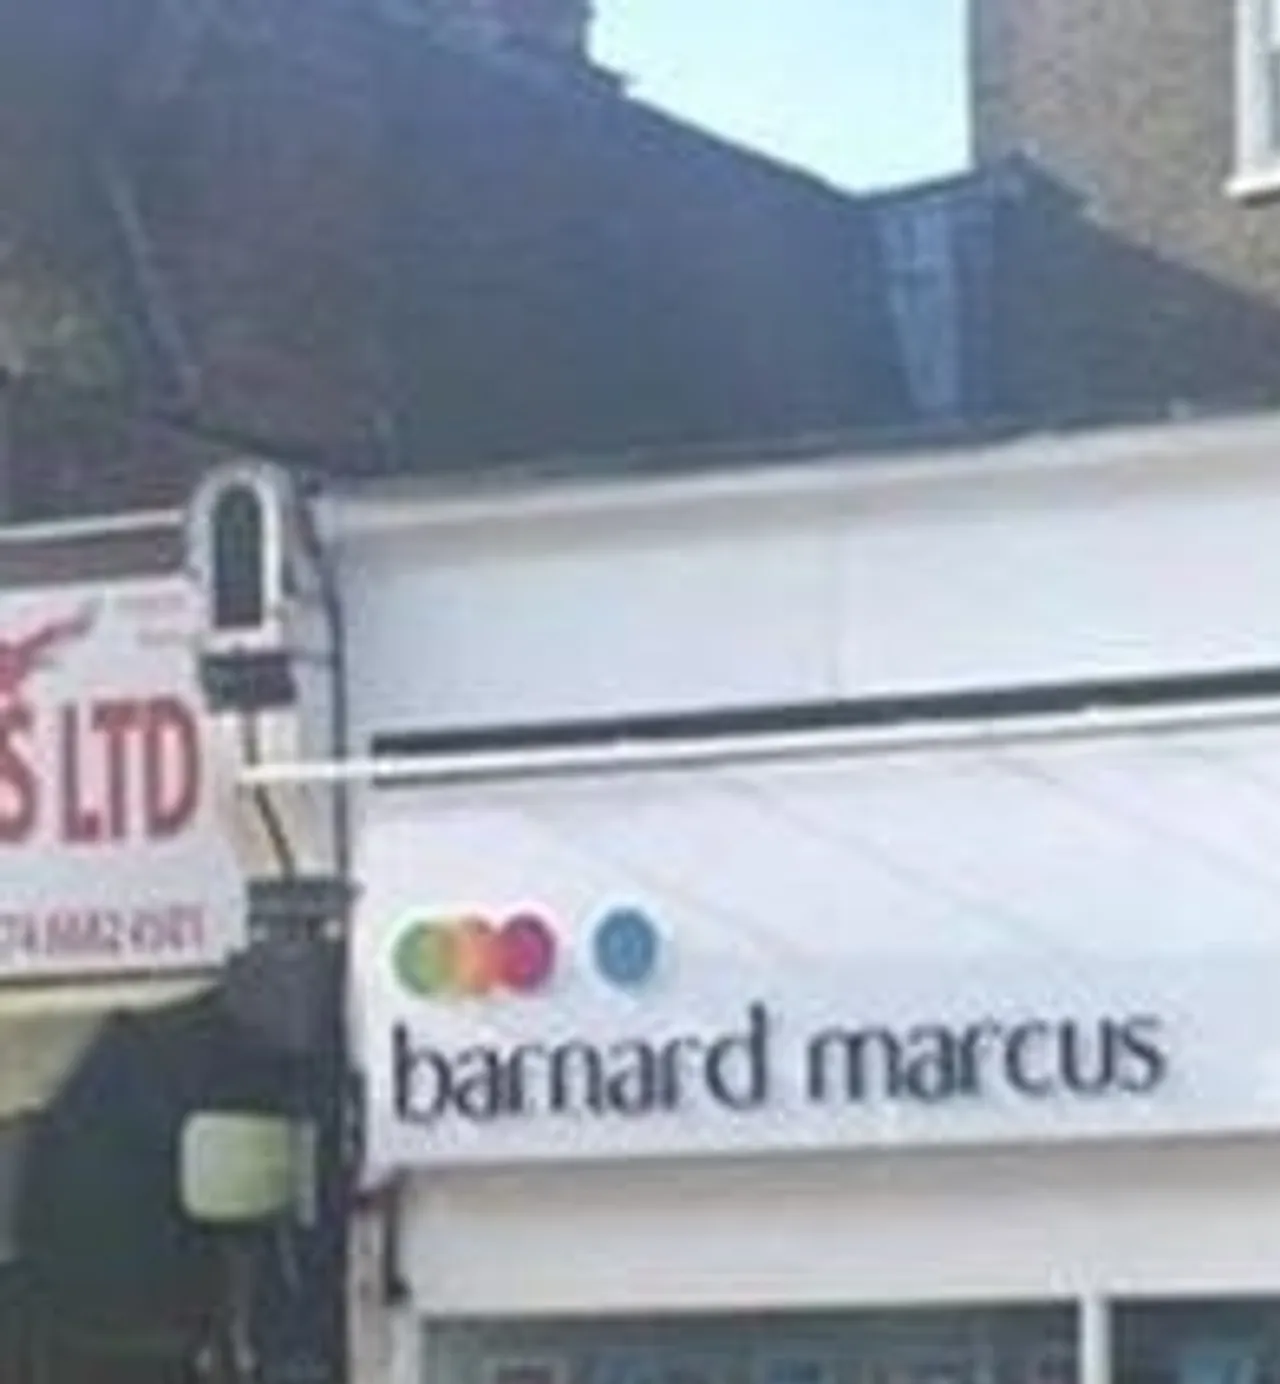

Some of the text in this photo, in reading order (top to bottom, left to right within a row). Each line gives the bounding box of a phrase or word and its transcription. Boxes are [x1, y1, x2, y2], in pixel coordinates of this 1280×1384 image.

[61, 696, 201, 843] LTD
[391, 1000, 1168, 1124] barnard marcus
